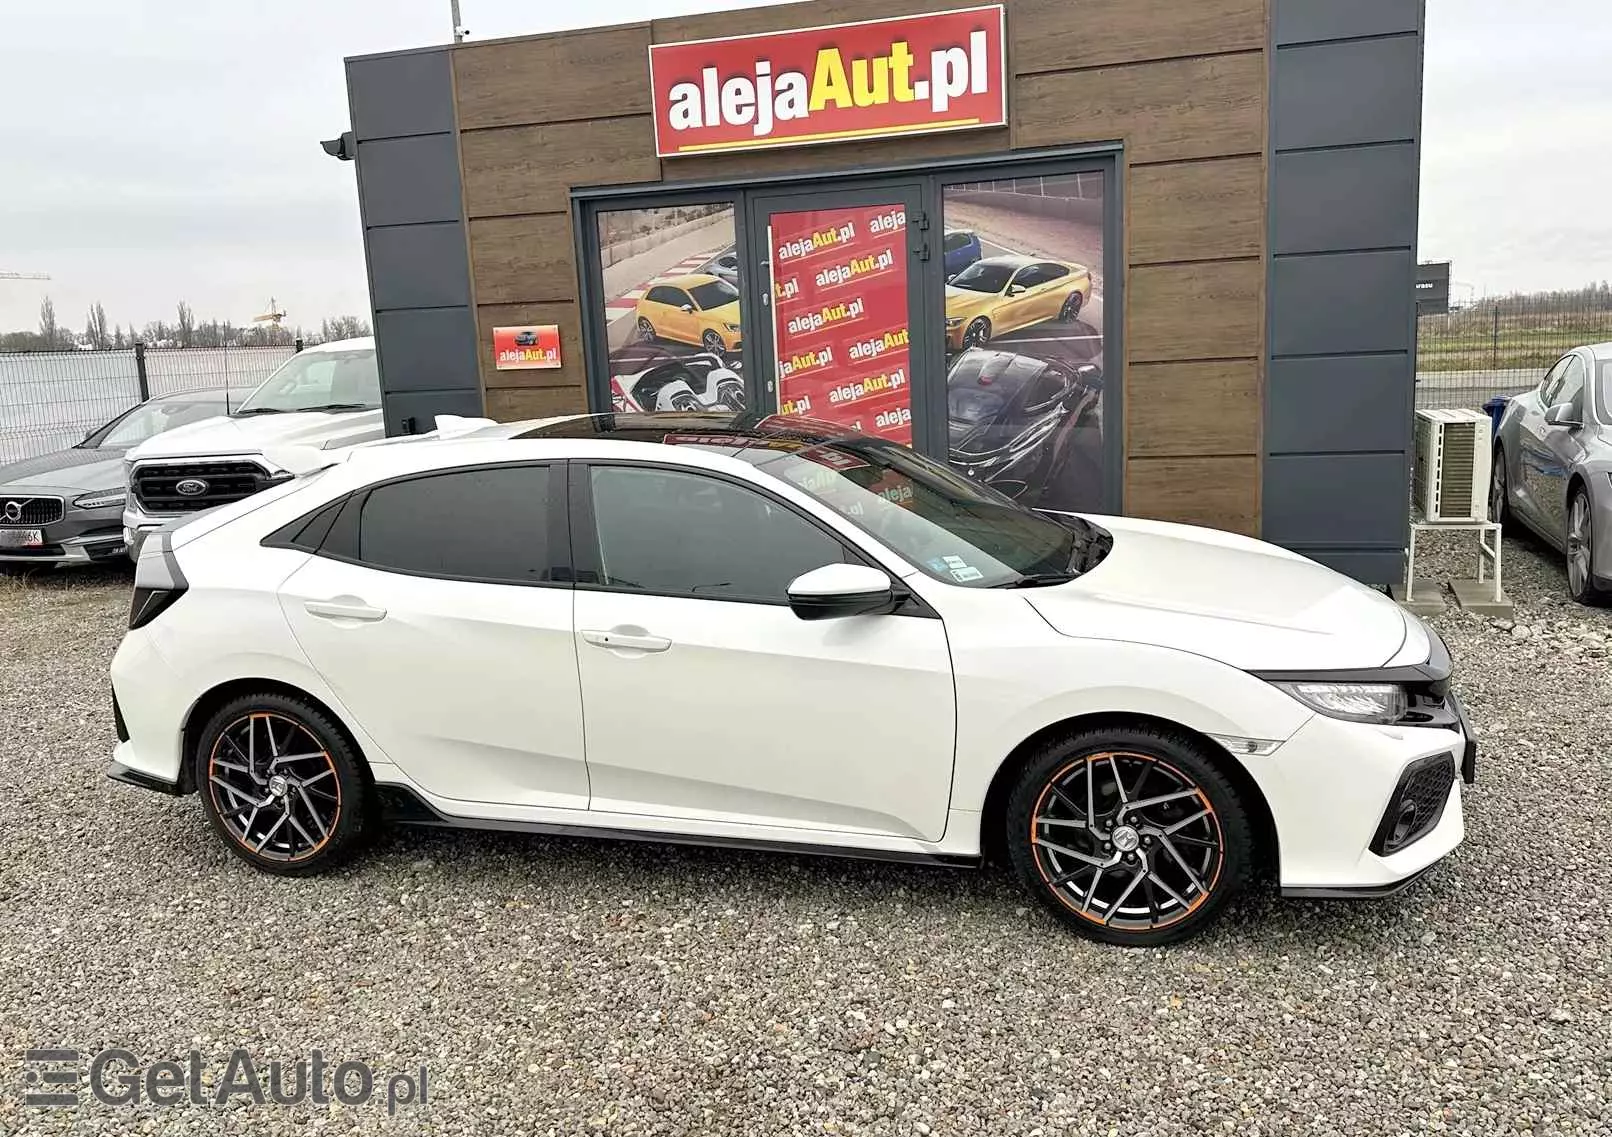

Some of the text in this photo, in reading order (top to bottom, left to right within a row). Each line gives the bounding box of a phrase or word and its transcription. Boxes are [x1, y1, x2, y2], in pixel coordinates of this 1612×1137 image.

[668, 30, 988, 136] alejaAut.pl
[778, 221, 856, 260] alejaAut.pl
[815, 248, 894, 287] alejaAut.pl
[787, 297, 865, 334] alejaAut.pl
[499, 347, 557, 363] alejaAut.pl
[828, 368, 906, 403] alejaAut.pl
[874, 407, 912, 428] aleja
